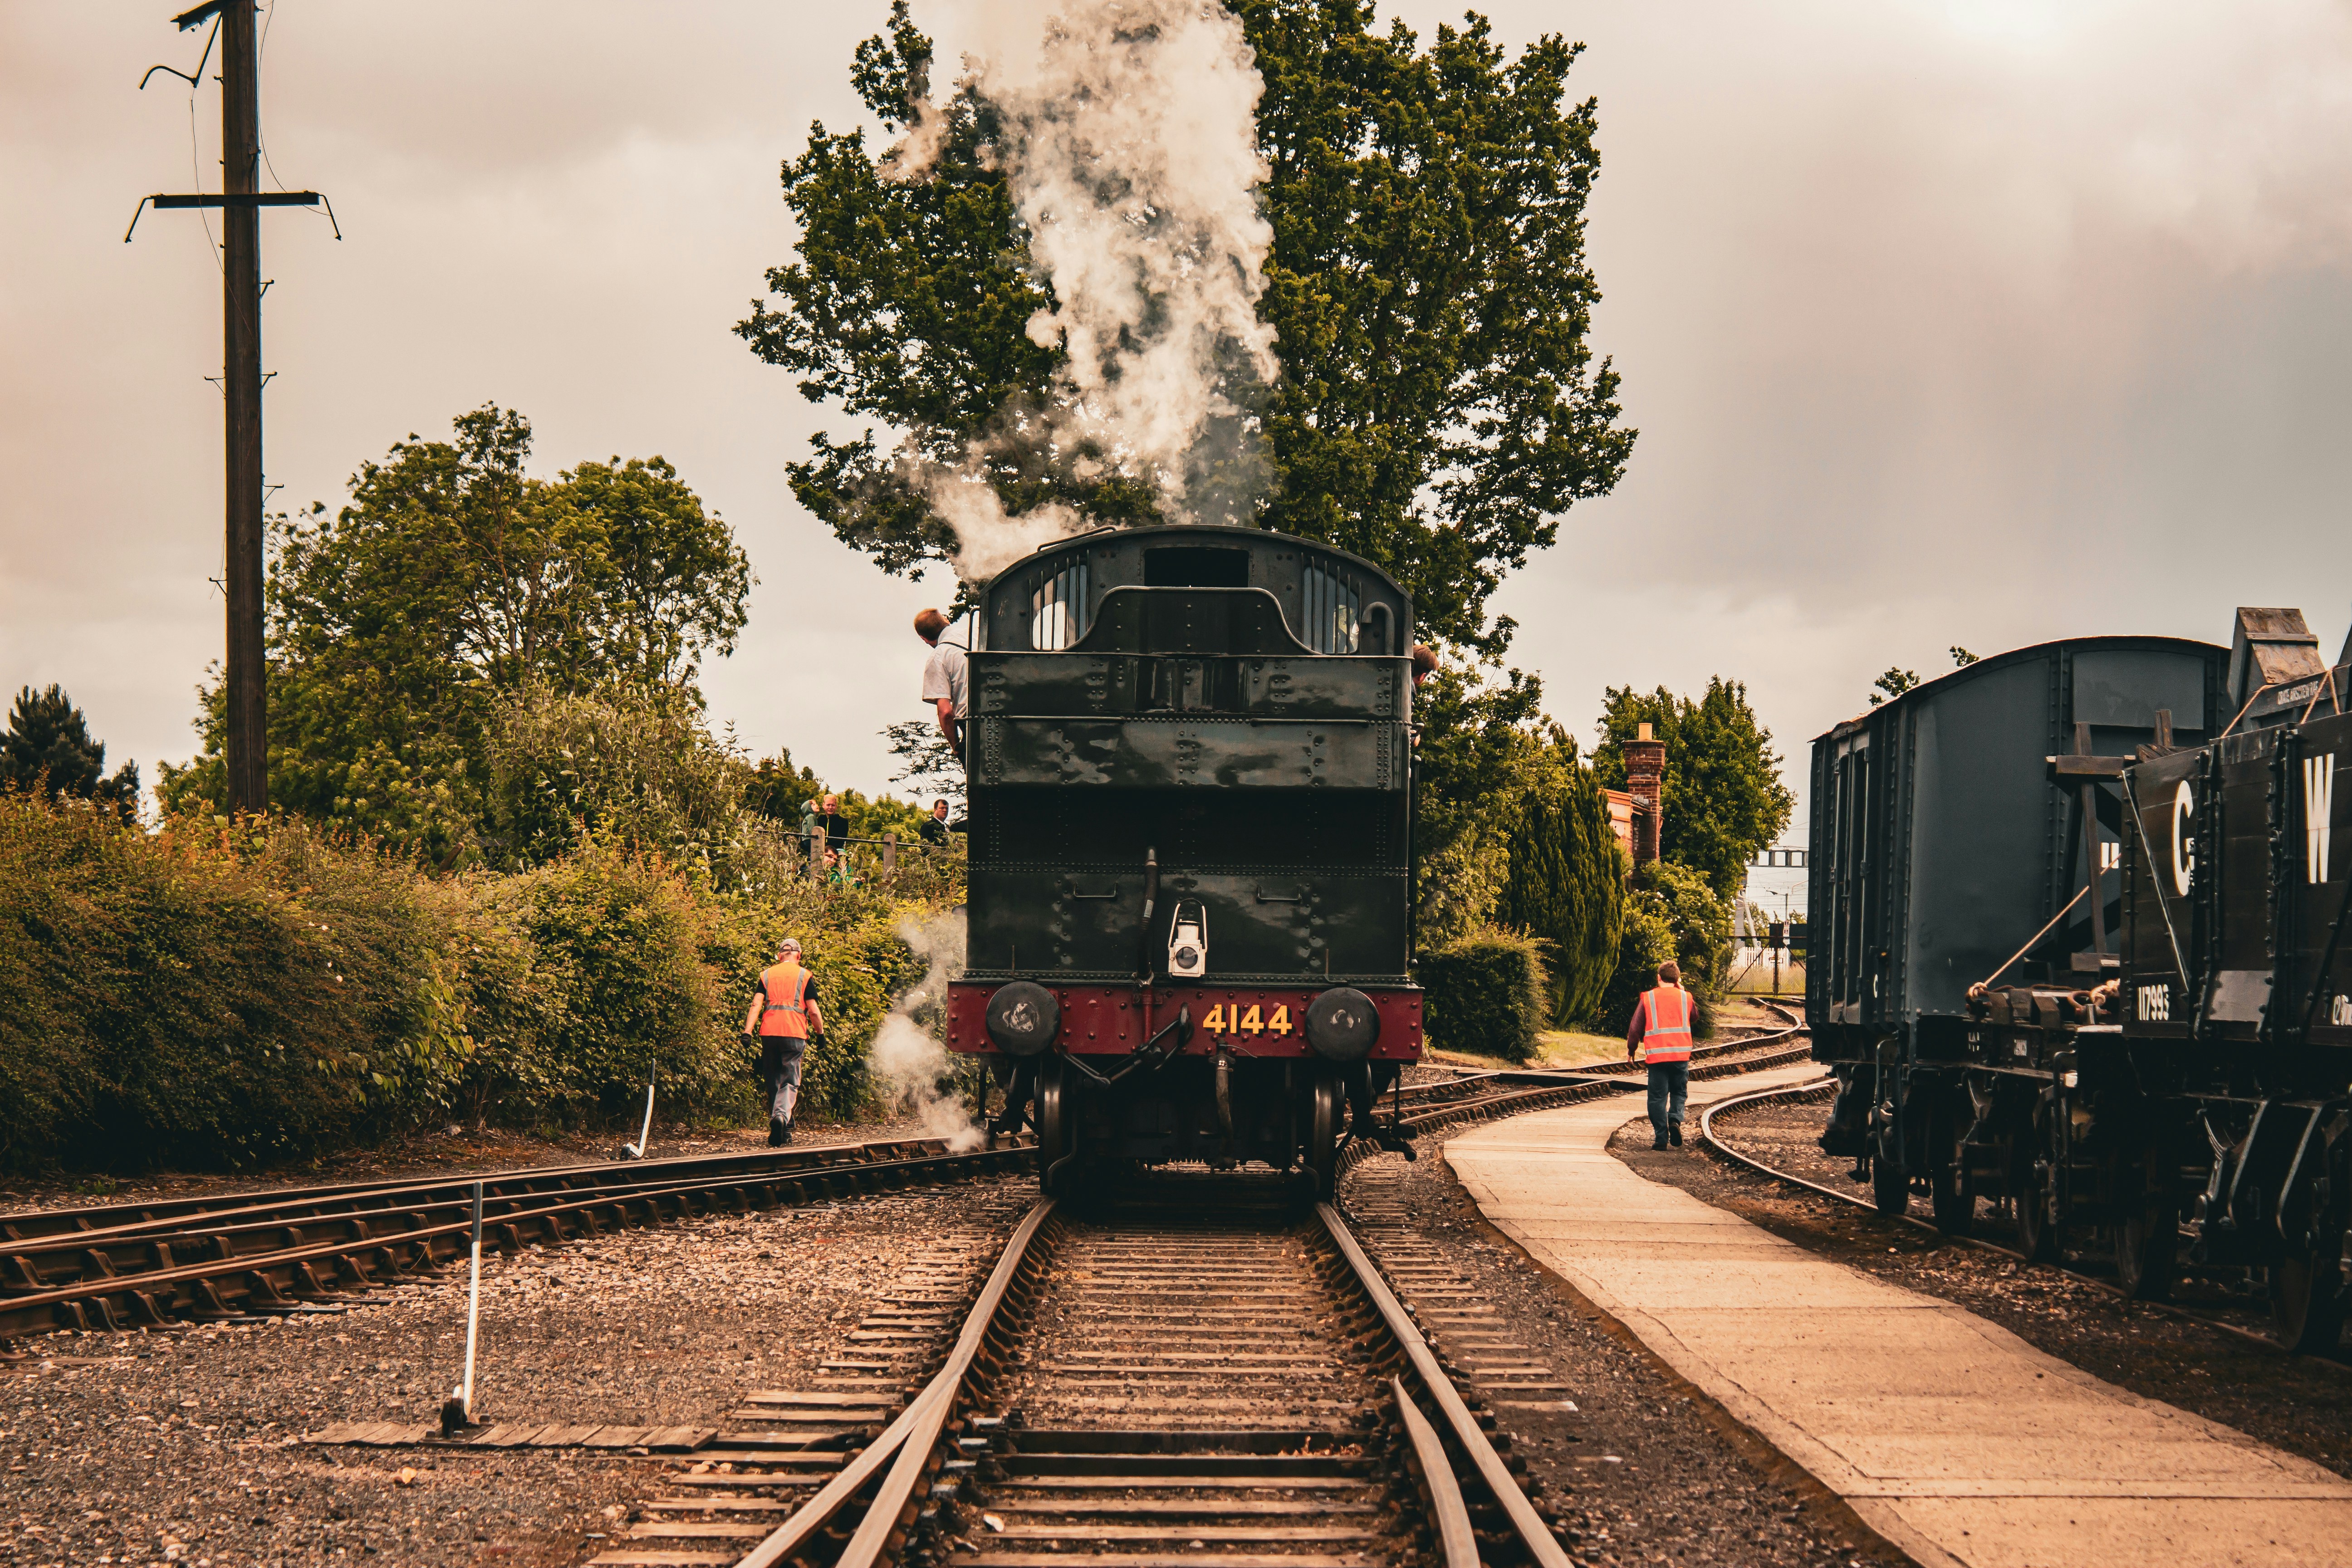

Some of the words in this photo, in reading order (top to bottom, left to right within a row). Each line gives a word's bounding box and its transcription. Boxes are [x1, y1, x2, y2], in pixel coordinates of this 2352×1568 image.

[2173, 779, 2195, 897] G
[2304, 753, 2334, 883] W
[1203, 1004, 1292, 1035] 4144
